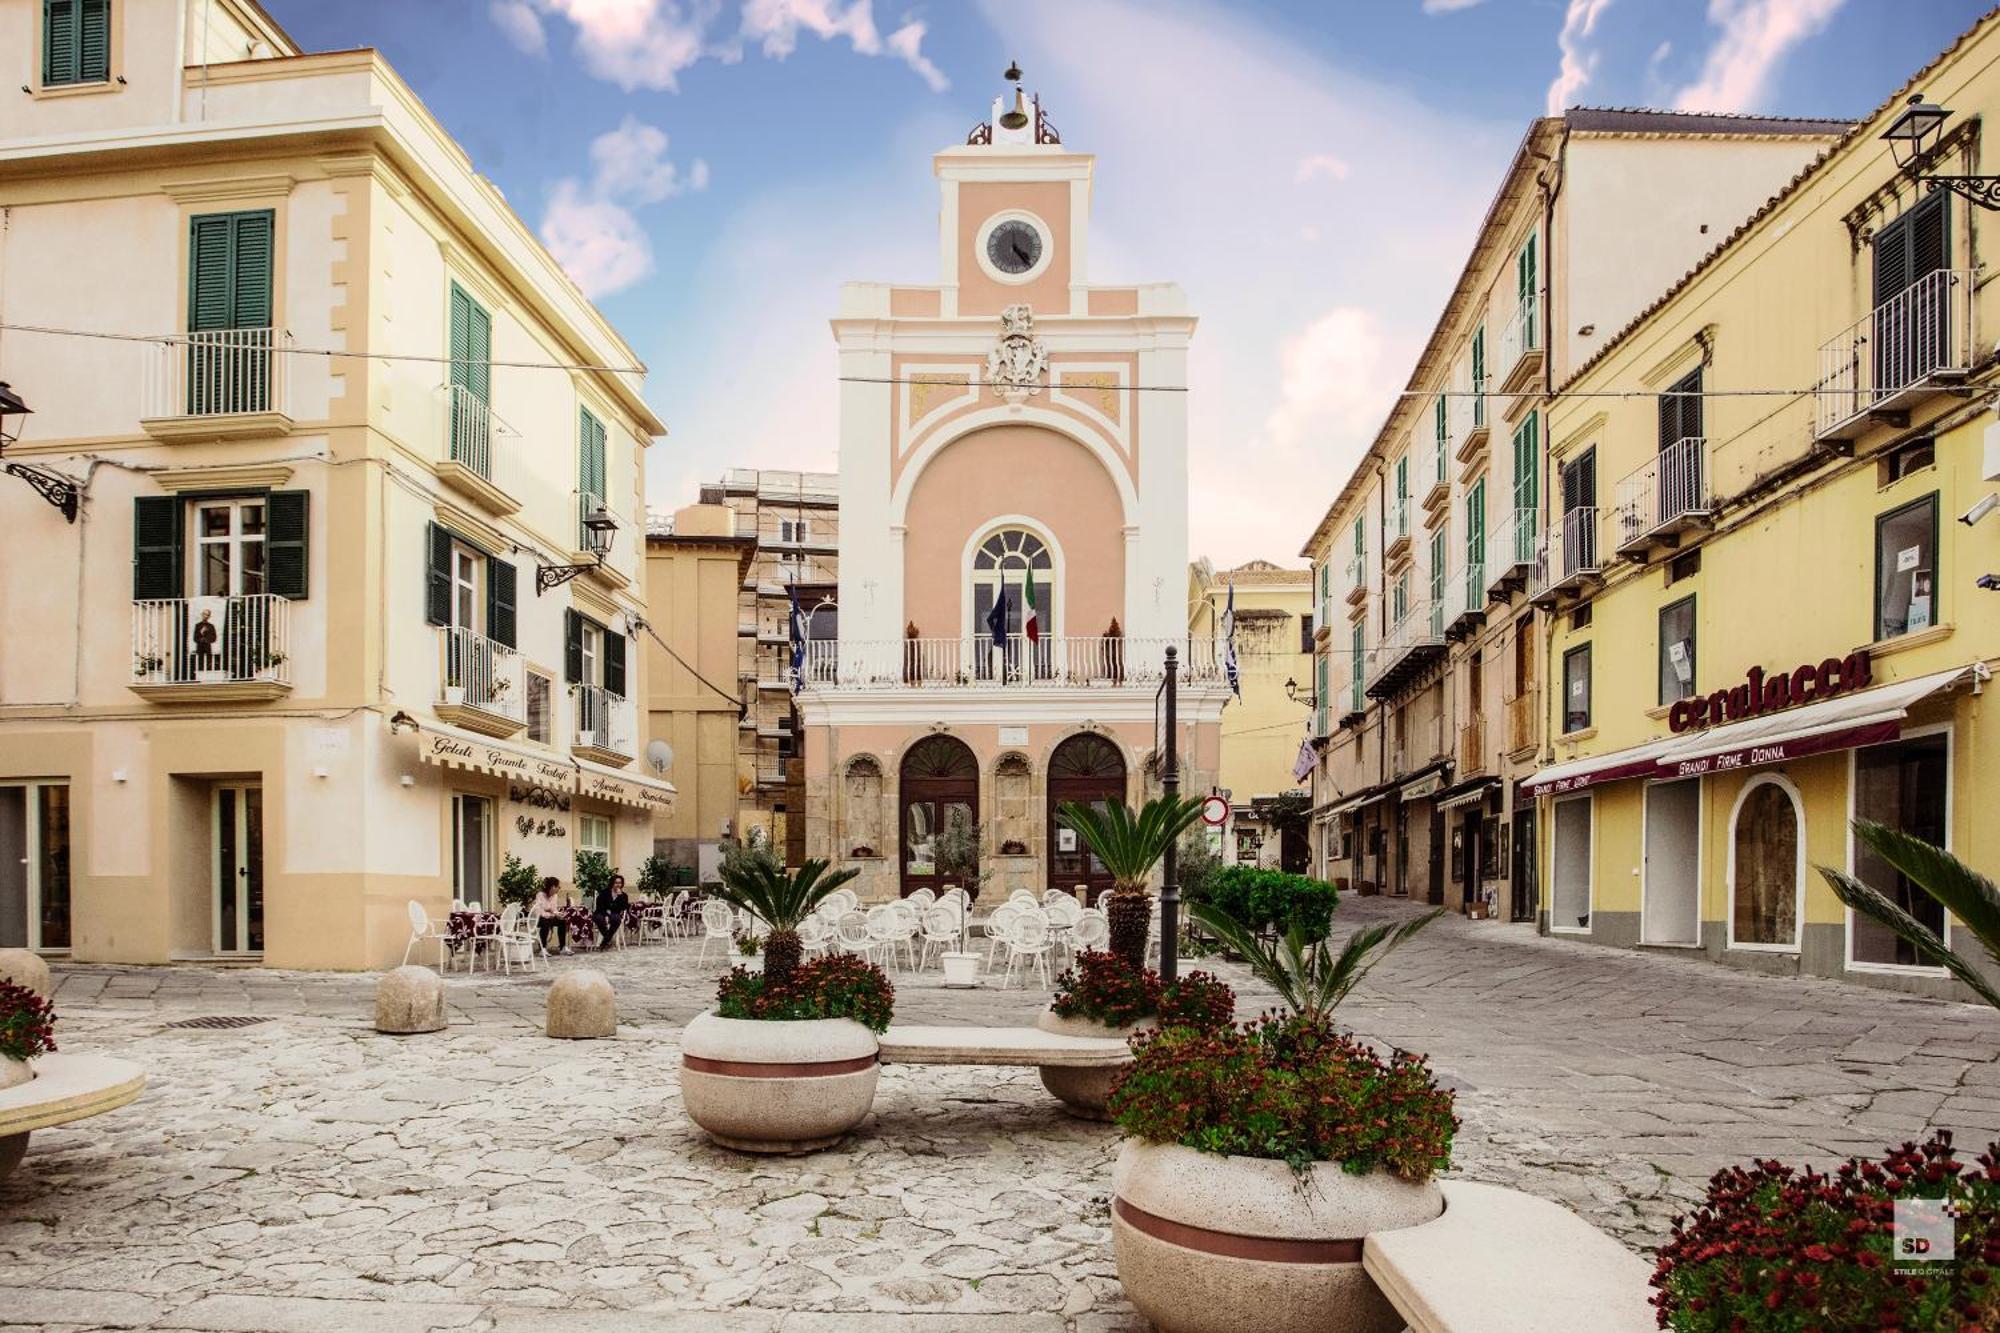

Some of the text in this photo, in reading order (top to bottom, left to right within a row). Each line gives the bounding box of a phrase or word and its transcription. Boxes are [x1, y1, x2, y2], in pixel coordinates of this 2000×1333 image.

[1669, 650, 1874, 733] ceralacca
[432, 736, 472, 757] Gelati
[1679, 746, 1785, 775] GRANDI FIRME DONNA
